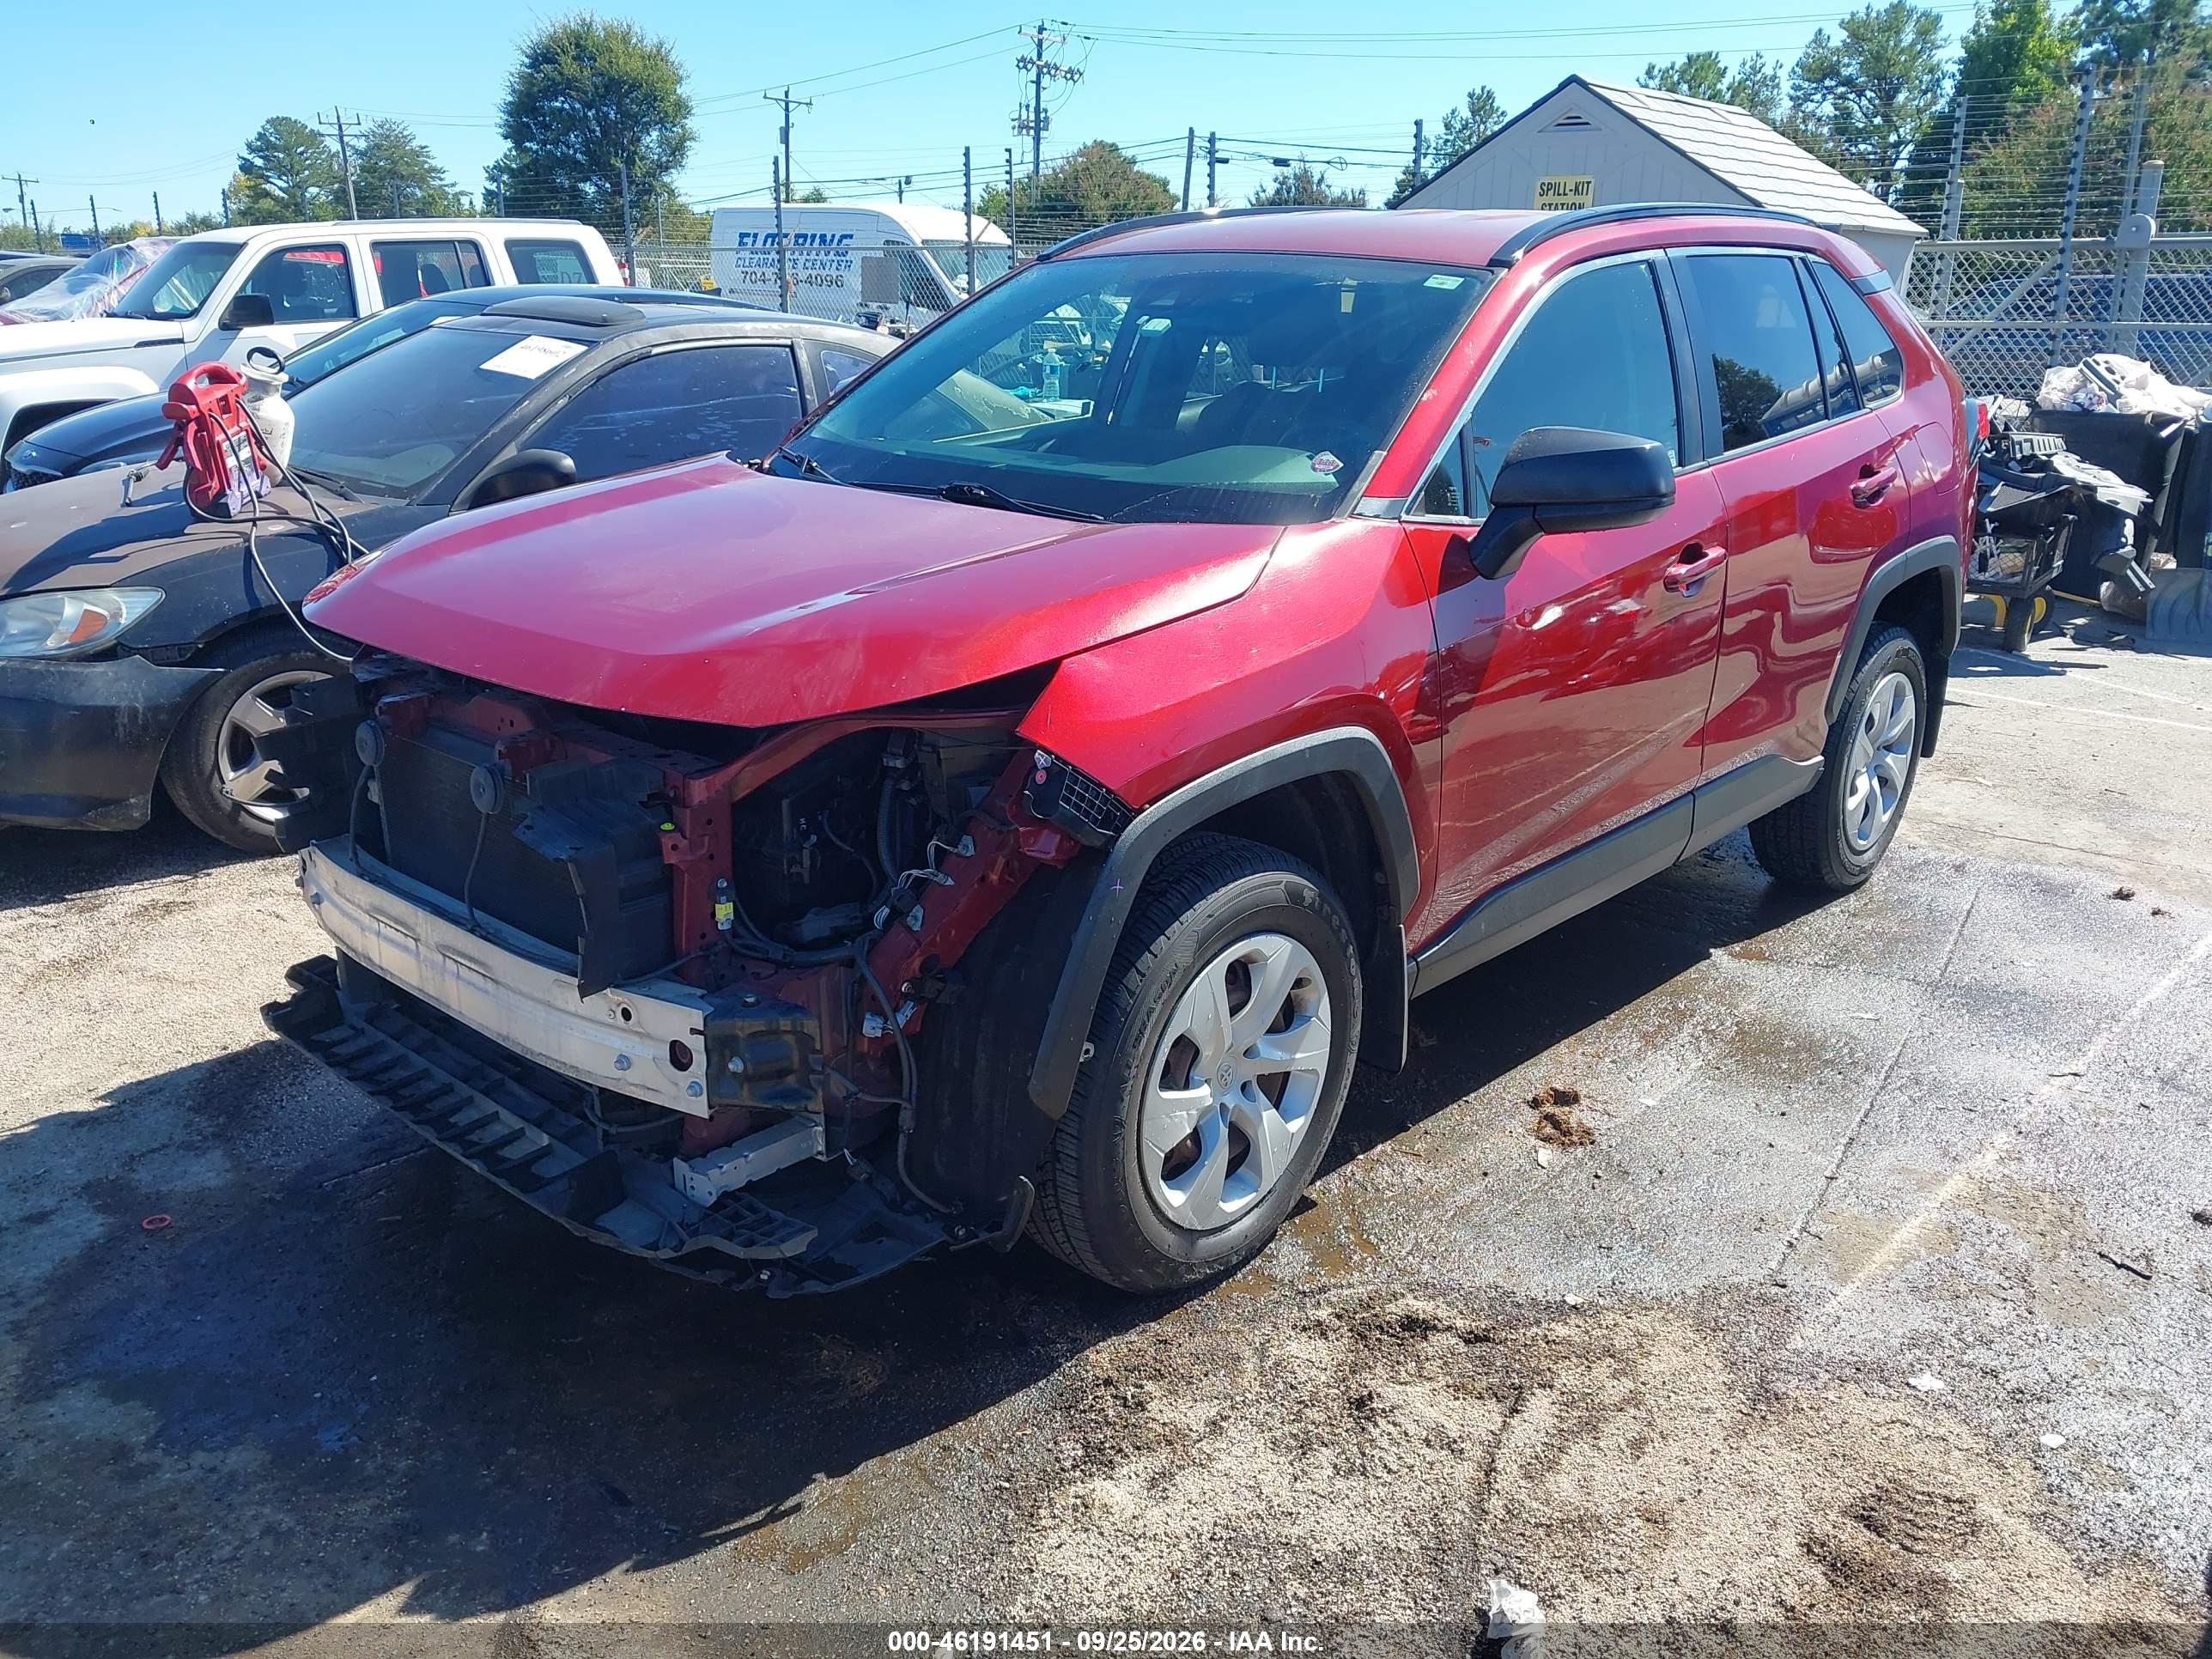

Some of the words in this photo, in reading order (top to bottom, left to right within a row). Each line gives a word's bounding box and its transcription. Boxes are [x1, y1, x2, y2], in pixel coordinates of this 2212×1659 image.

[1539, 181, 1591, 197] SPILL-KIT
[735, 233, 854, 257] FLORING
[735, 258, 799, 270] CLEARAE
[803, 259, 853, 271] CENTER
[741, 270, 845, 288] 704-76-4096
